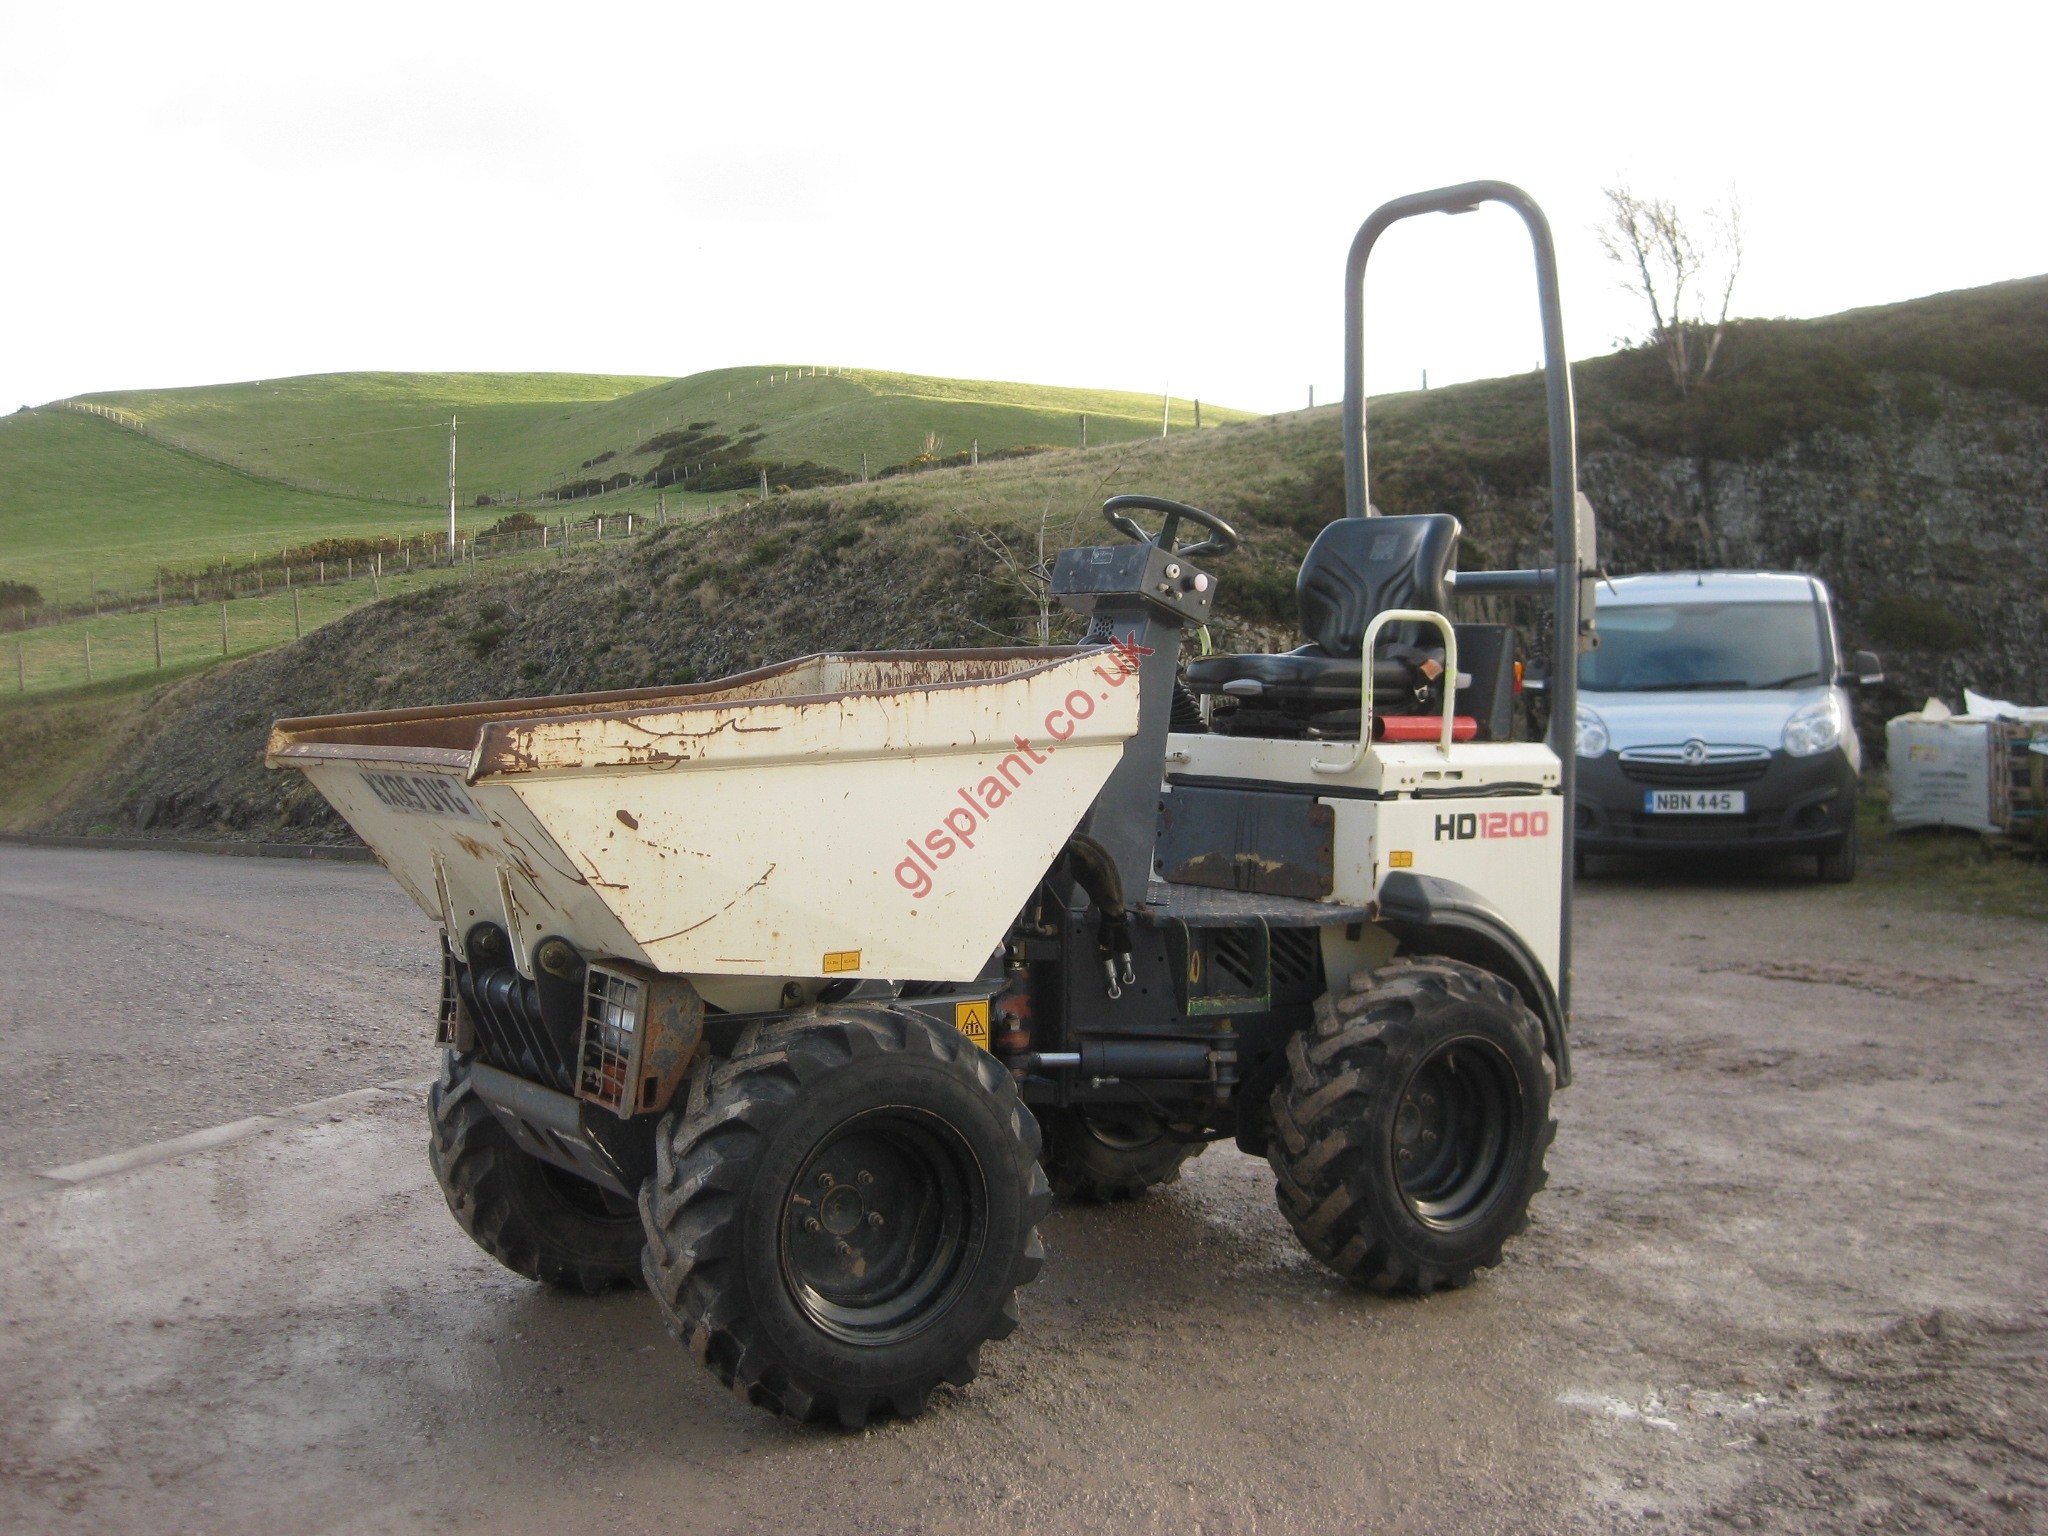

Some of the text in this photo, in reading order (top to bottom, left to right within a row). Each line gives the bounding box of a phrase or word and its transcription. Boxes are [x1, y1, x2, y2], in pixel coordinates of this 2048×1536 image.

[1657, 794, 1731, 810] NBN 445
[1434, 811, 1549, 841] HD1200
